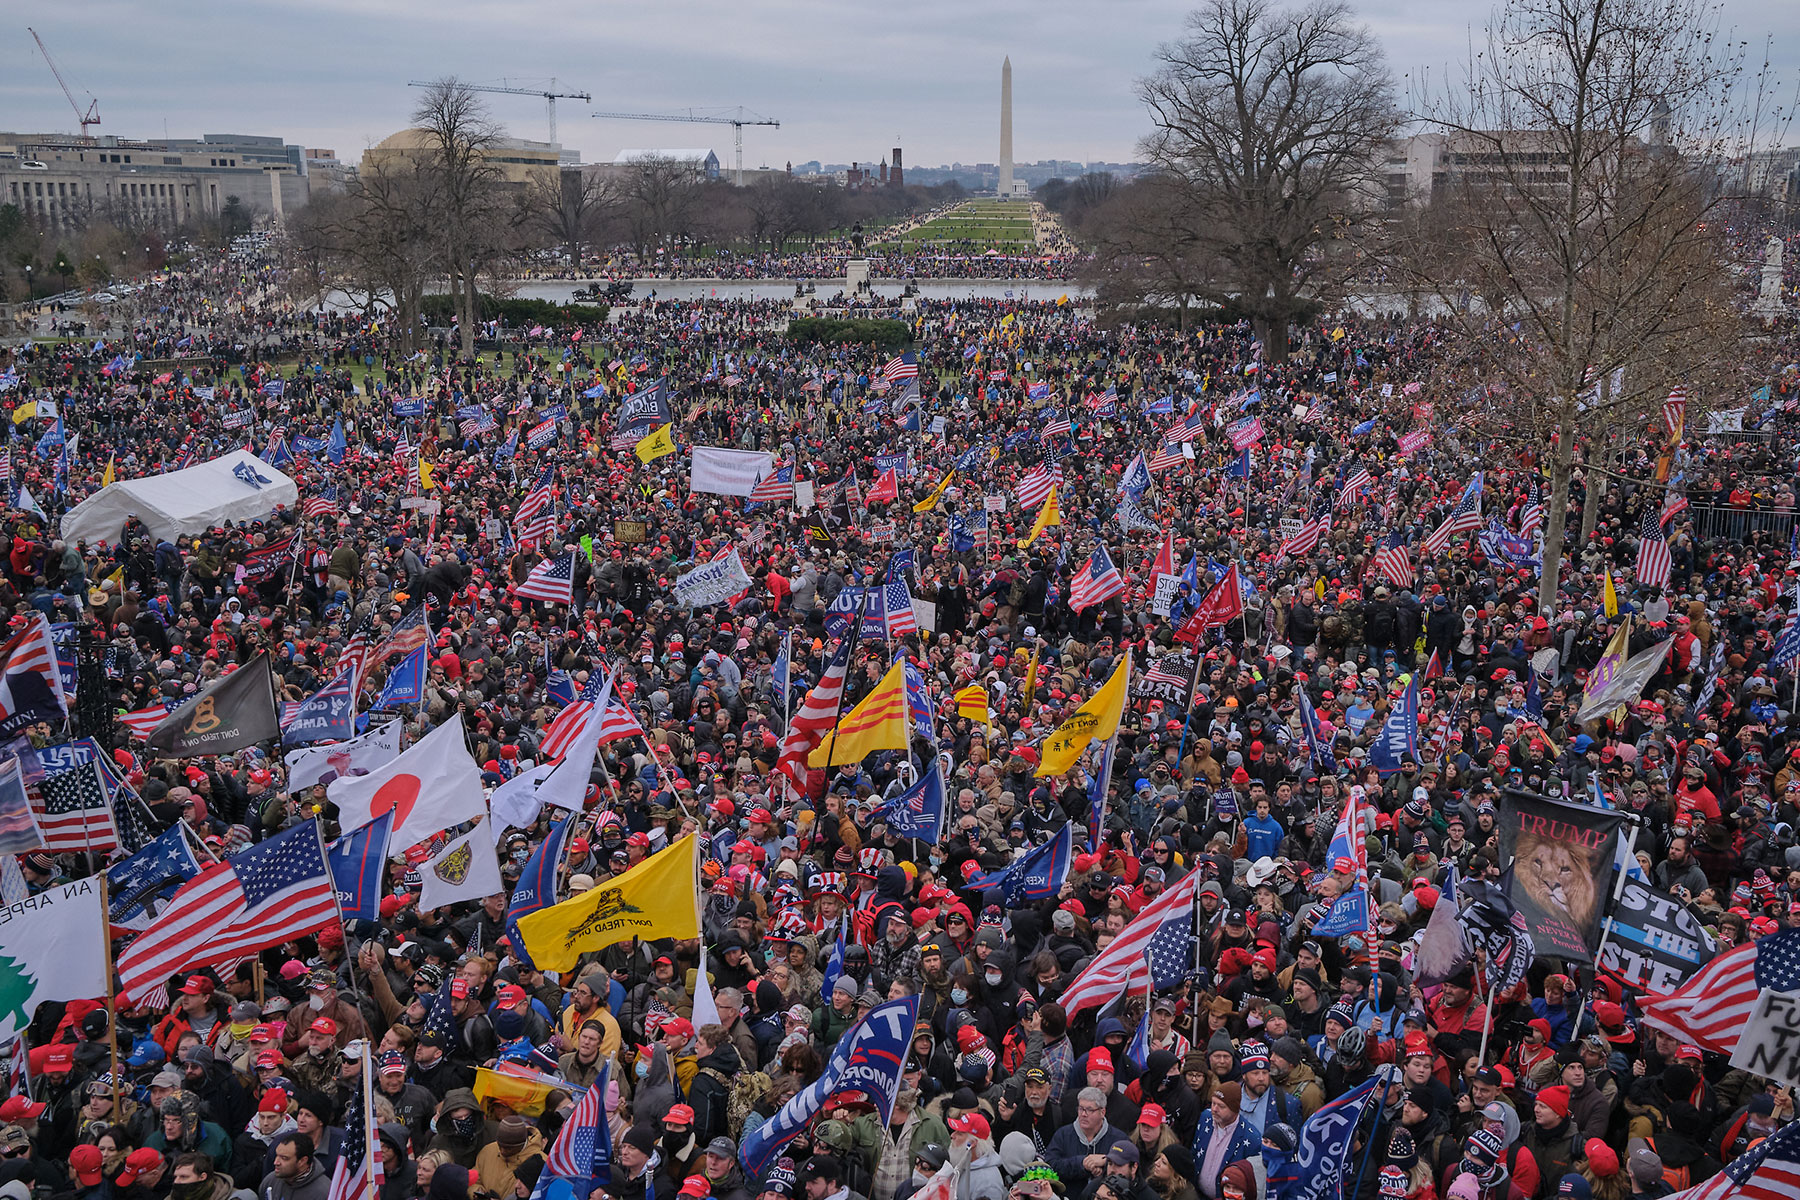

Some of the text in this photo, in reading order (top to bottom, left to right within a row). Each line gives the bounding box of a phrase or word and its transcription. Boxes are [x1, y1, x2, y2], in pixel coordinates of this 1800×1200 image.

[2, 709, 38, 732] WIN!
[1517, 811, 1608, 850] TRUMP
[1536, 925, 1573, 940] NEVER
[1643, 922, 1700, 962] THE
[1602, 938, 1684, 998] STE
